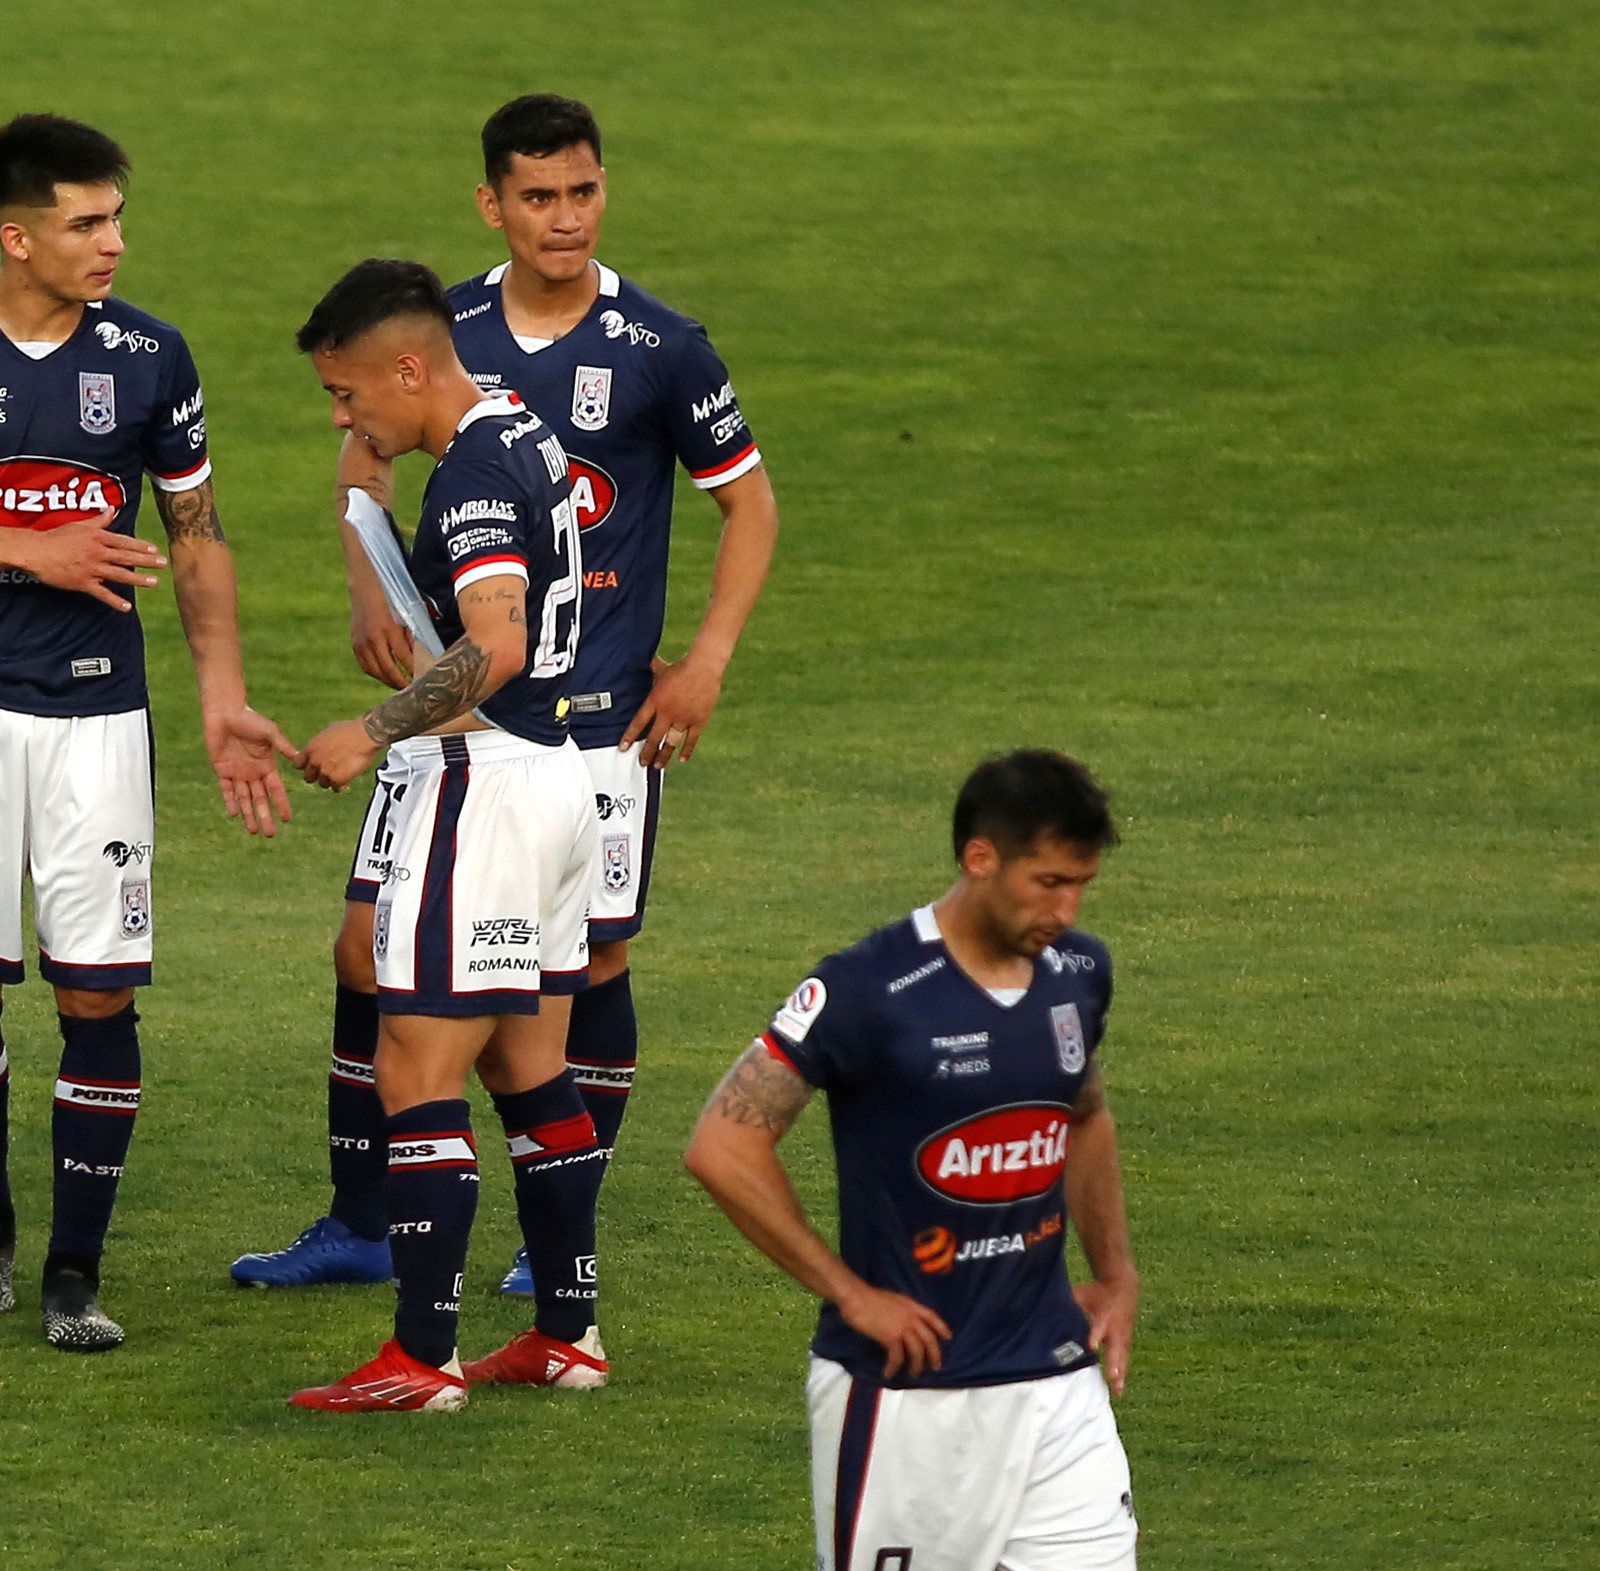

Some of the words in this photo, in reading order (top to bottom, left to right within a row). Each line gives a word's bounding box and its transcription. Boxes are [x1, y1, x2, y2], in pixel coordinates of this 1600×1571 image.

[931, 1031, 989, 1049] TRAINING
[953, 1058, 992, 1074] MEDS
[331, 1135, 370, 1150] STO
